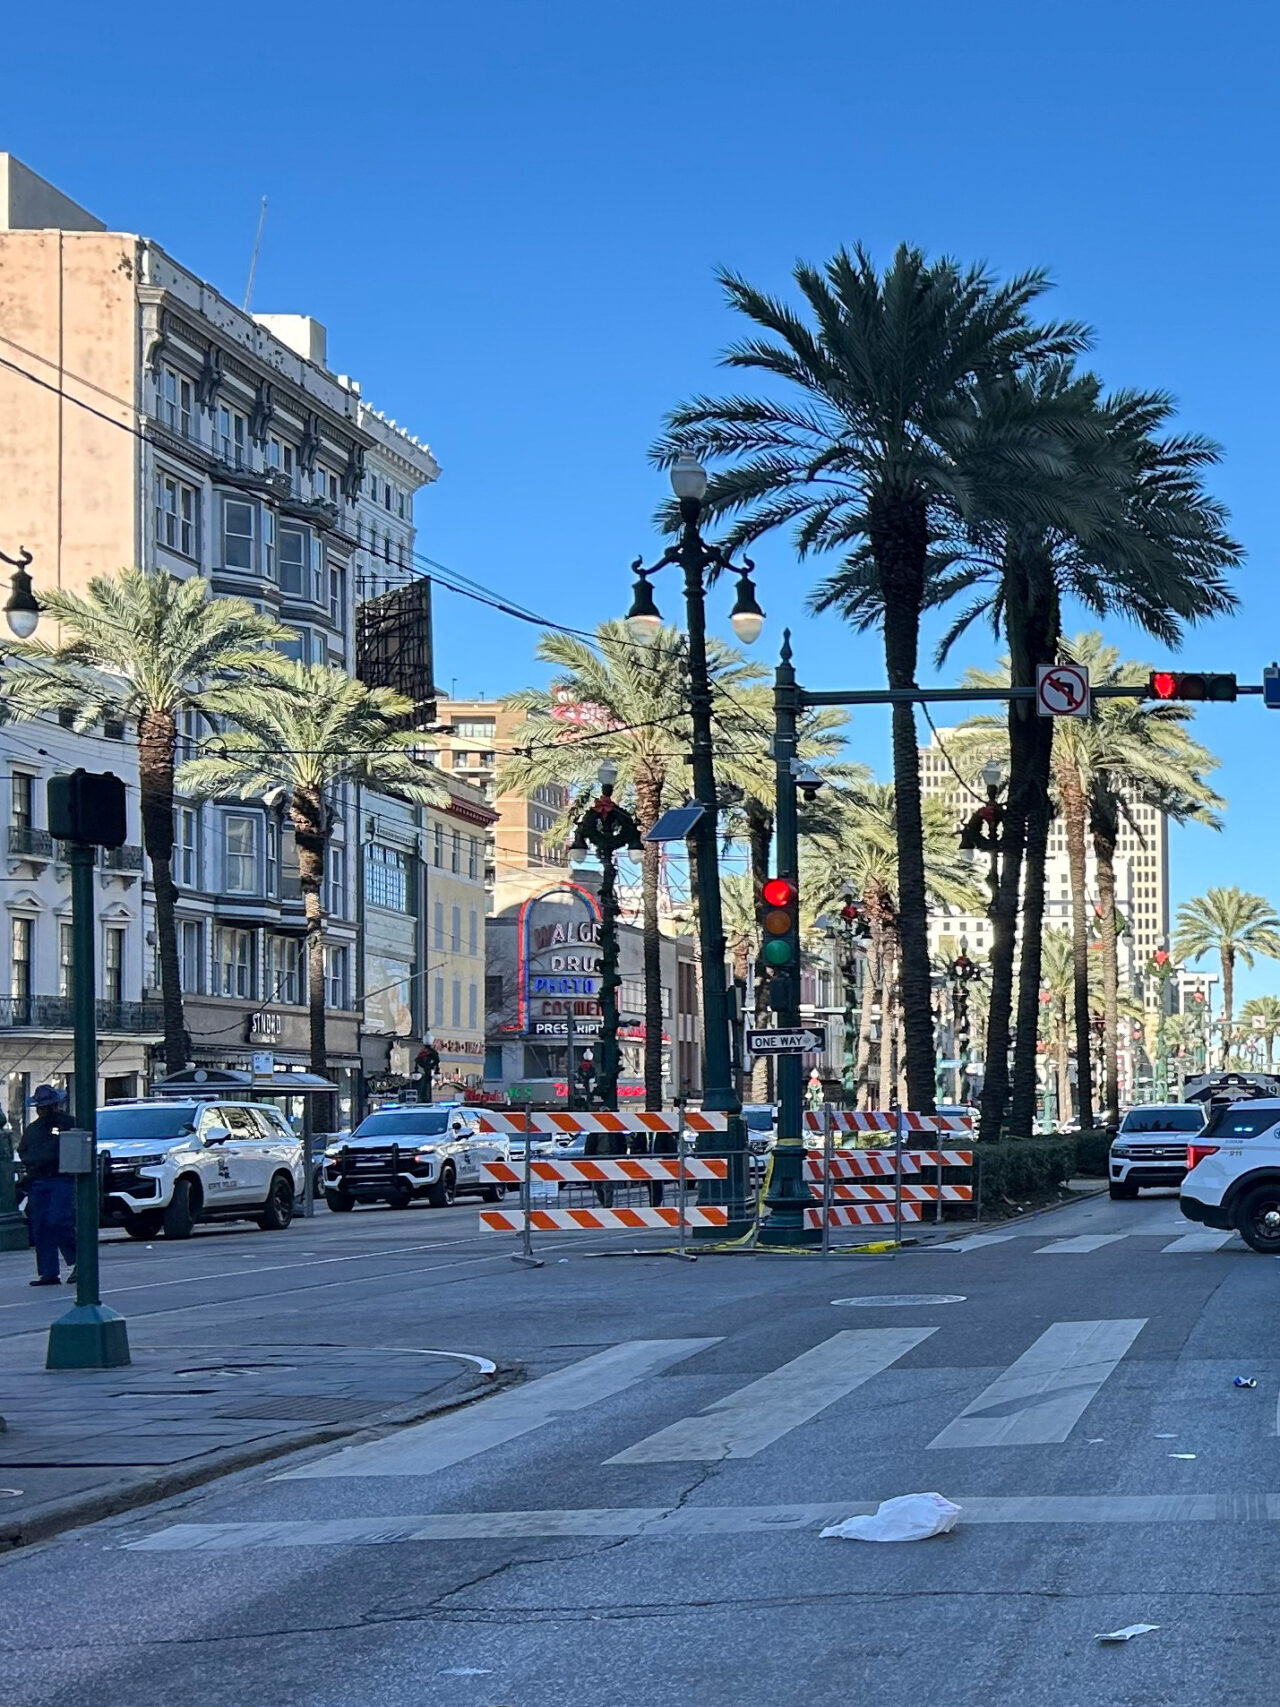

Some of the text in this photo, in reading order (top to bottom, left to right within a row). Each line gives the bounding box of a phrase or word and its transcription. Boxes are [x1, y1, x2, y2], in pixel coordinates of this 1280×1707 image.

[534, 921, 602, 948] WALGR
[551, 955, 600, 973] DRU
[534, 977, 595, 995] PHOTO
[542, 1000, 602, 1017] COSME
[536, 1023, 601, 1035] PRESRIPT
[755, 1036, 802, 1047] ONE WAY
